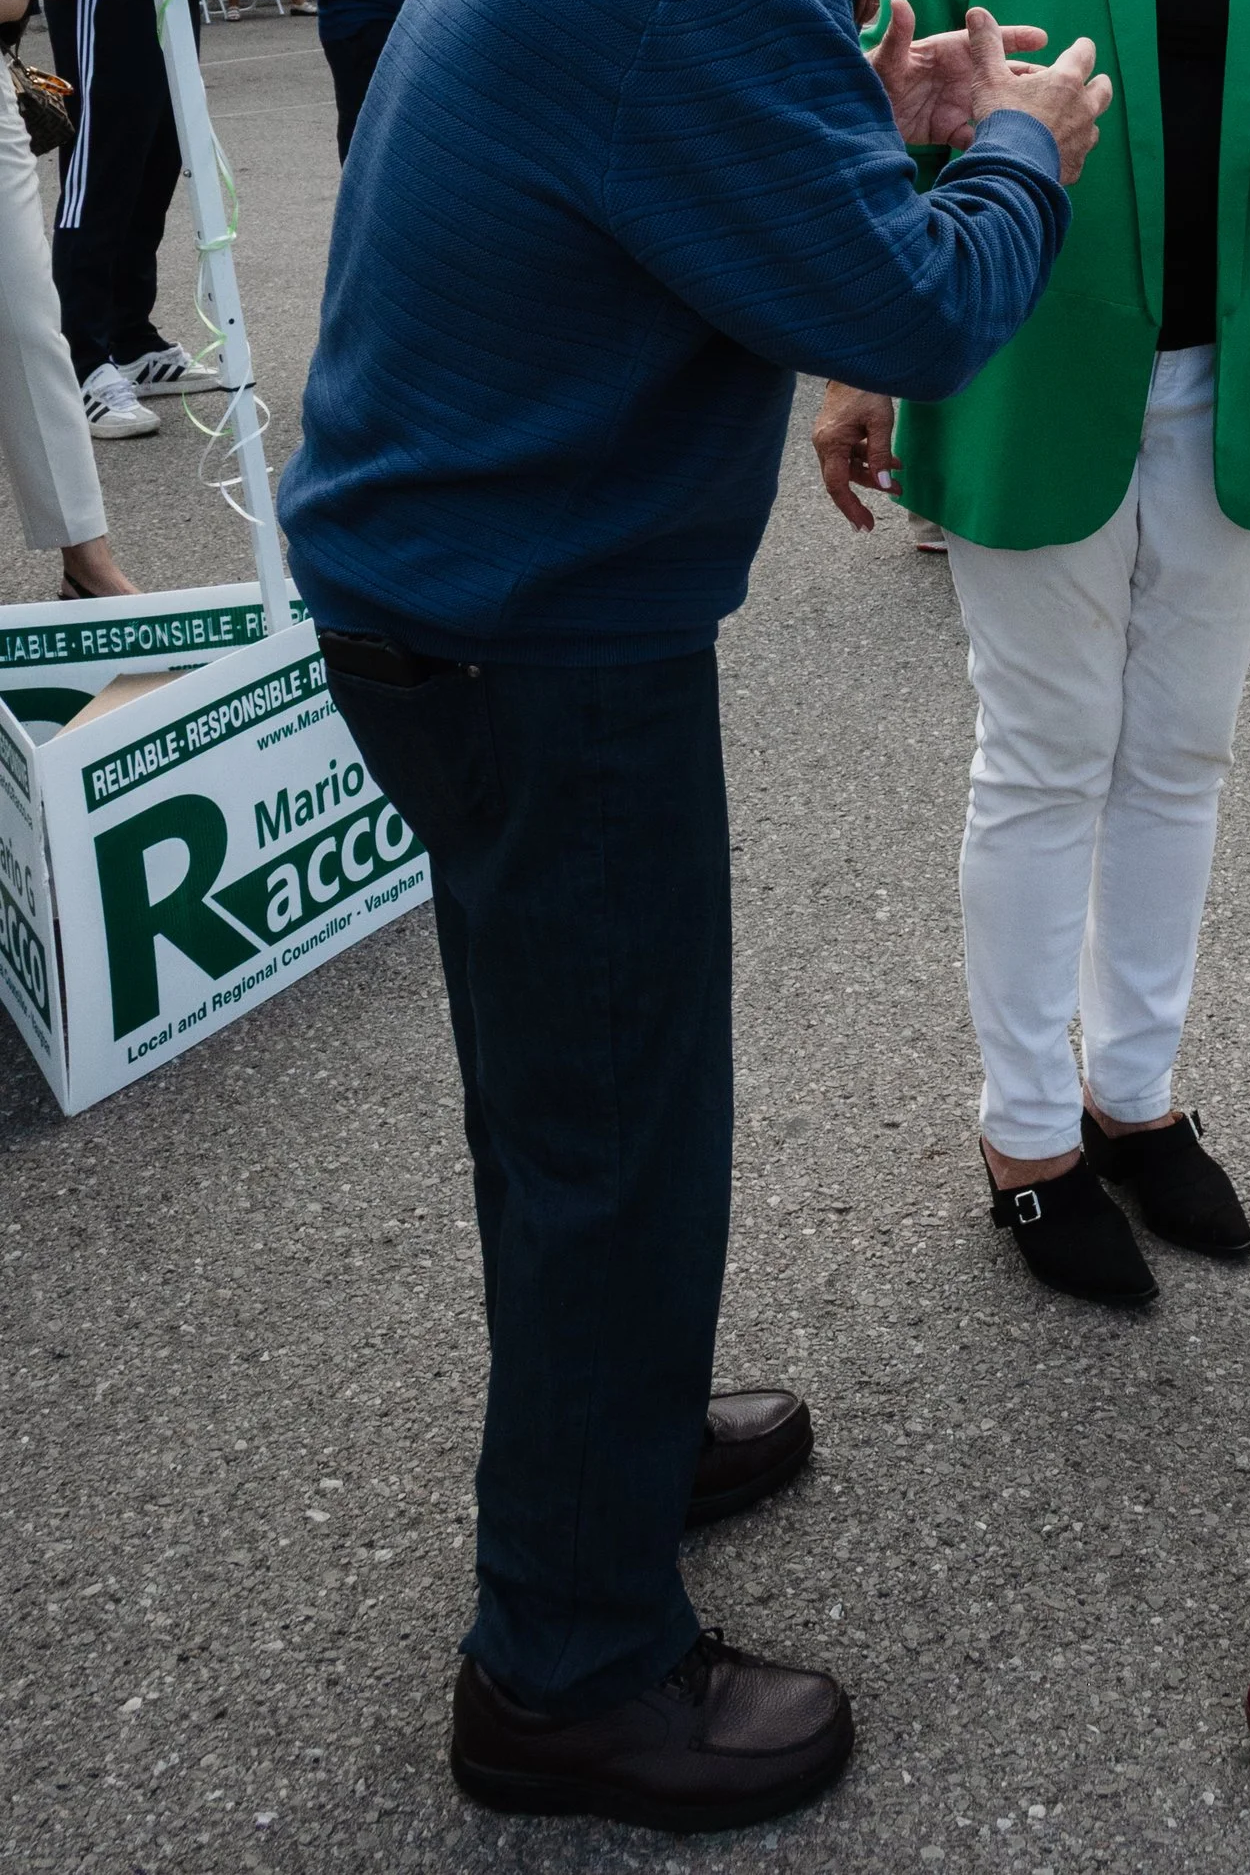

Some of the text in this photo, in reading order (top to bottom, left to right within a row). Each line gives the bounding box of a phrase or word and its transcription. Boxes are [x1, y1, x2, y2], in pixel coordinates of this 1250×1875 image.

[81, 614, 234, 656] RESPONSIBLE
[91, 730, 180, 802] RELIABLE
[185, 669, 302, 752] RESPONSIBLE
[253, 758, 365, 850] Mario
[127, 1021, 173, 1064] Local
[178, 1001, 207, 1034] and
[212, 955, 278, 1014] Regional
[281, 911, 352, 967] Councillor
[364, 869, 425, 914] Vaughan
